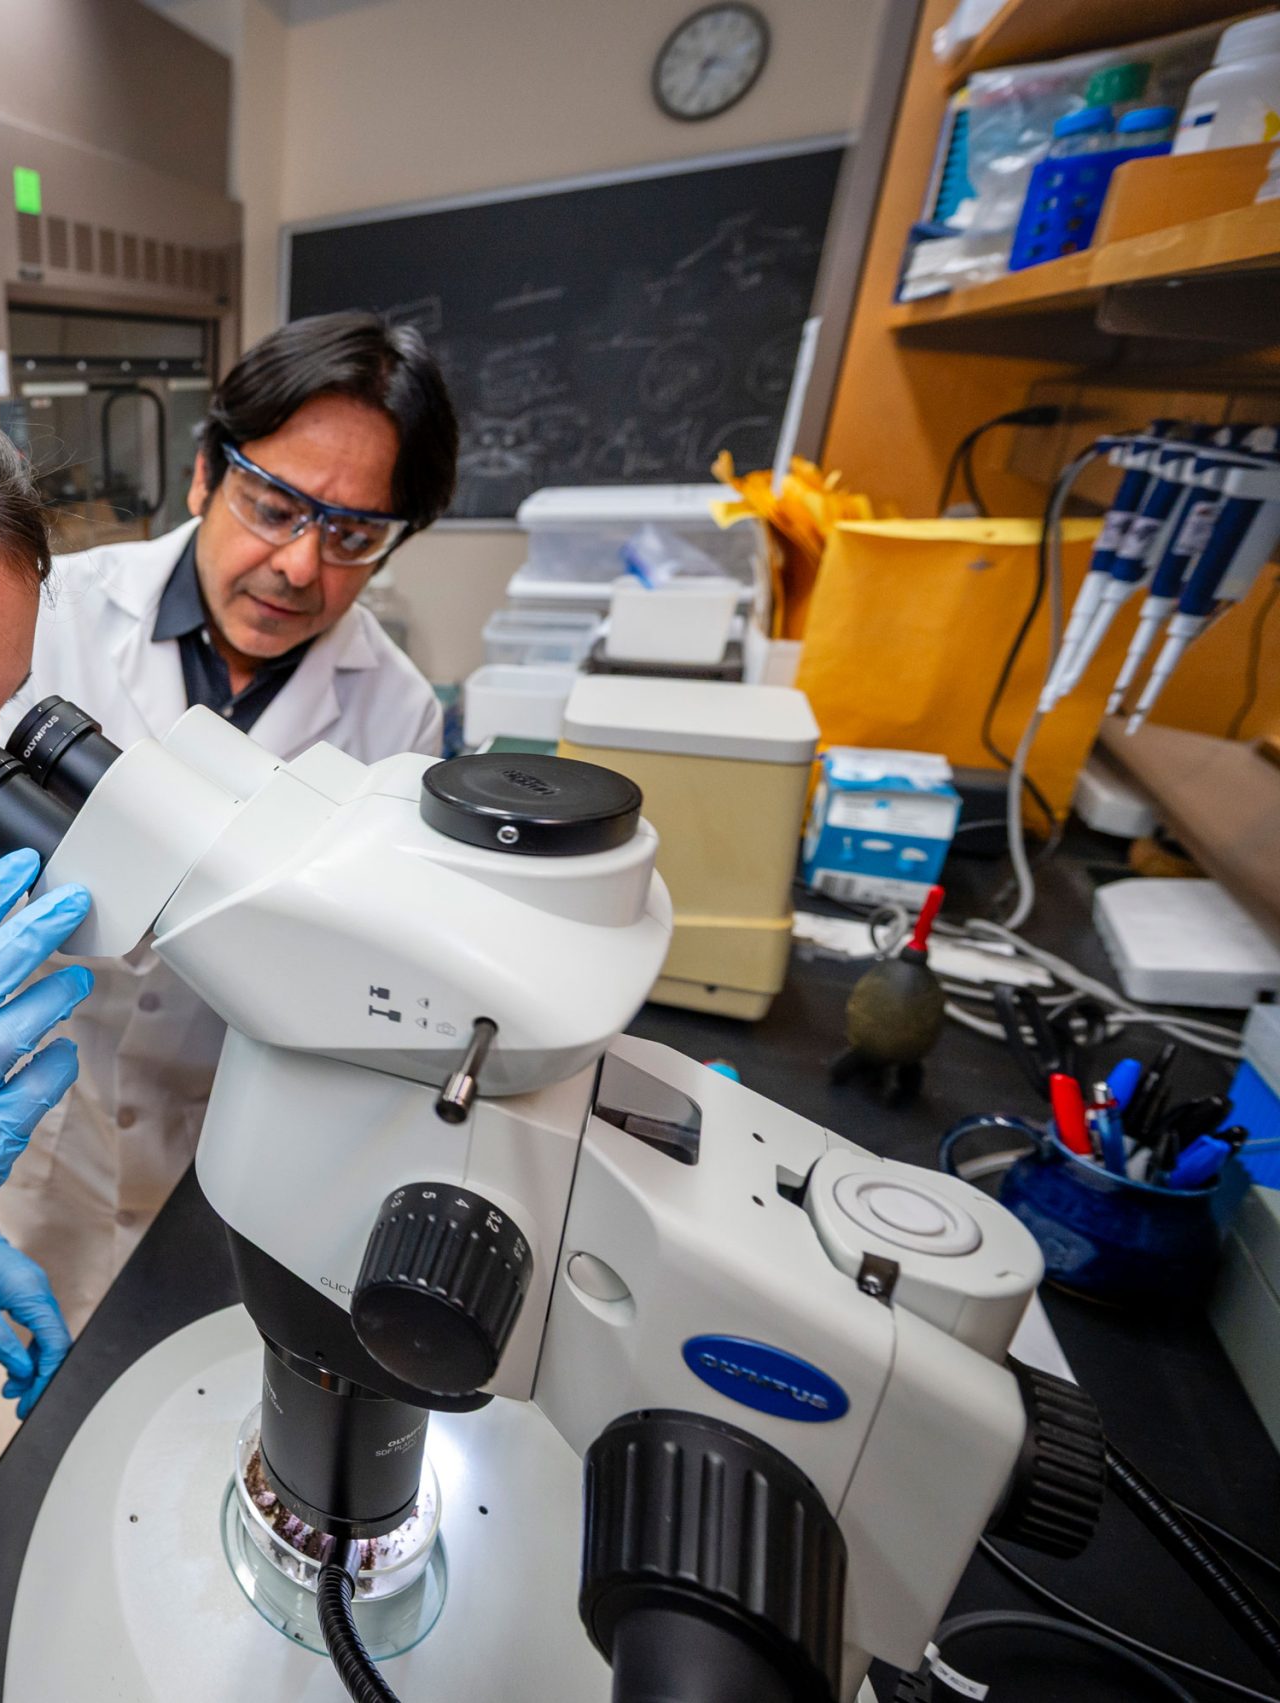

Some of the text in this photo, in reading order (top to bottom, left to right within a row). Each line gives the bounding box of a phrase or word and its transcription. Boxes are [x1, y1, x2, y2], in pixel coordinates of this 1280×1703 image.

[23, 714, 60, 758] OLYMPUS
[421, 1190, 437, 1199] 5
[454, 1198, 470, 1209] 4
[485, 1210, 503, 1233] 3.2
[699, 1352, 829, 1410] OLYMPUS
